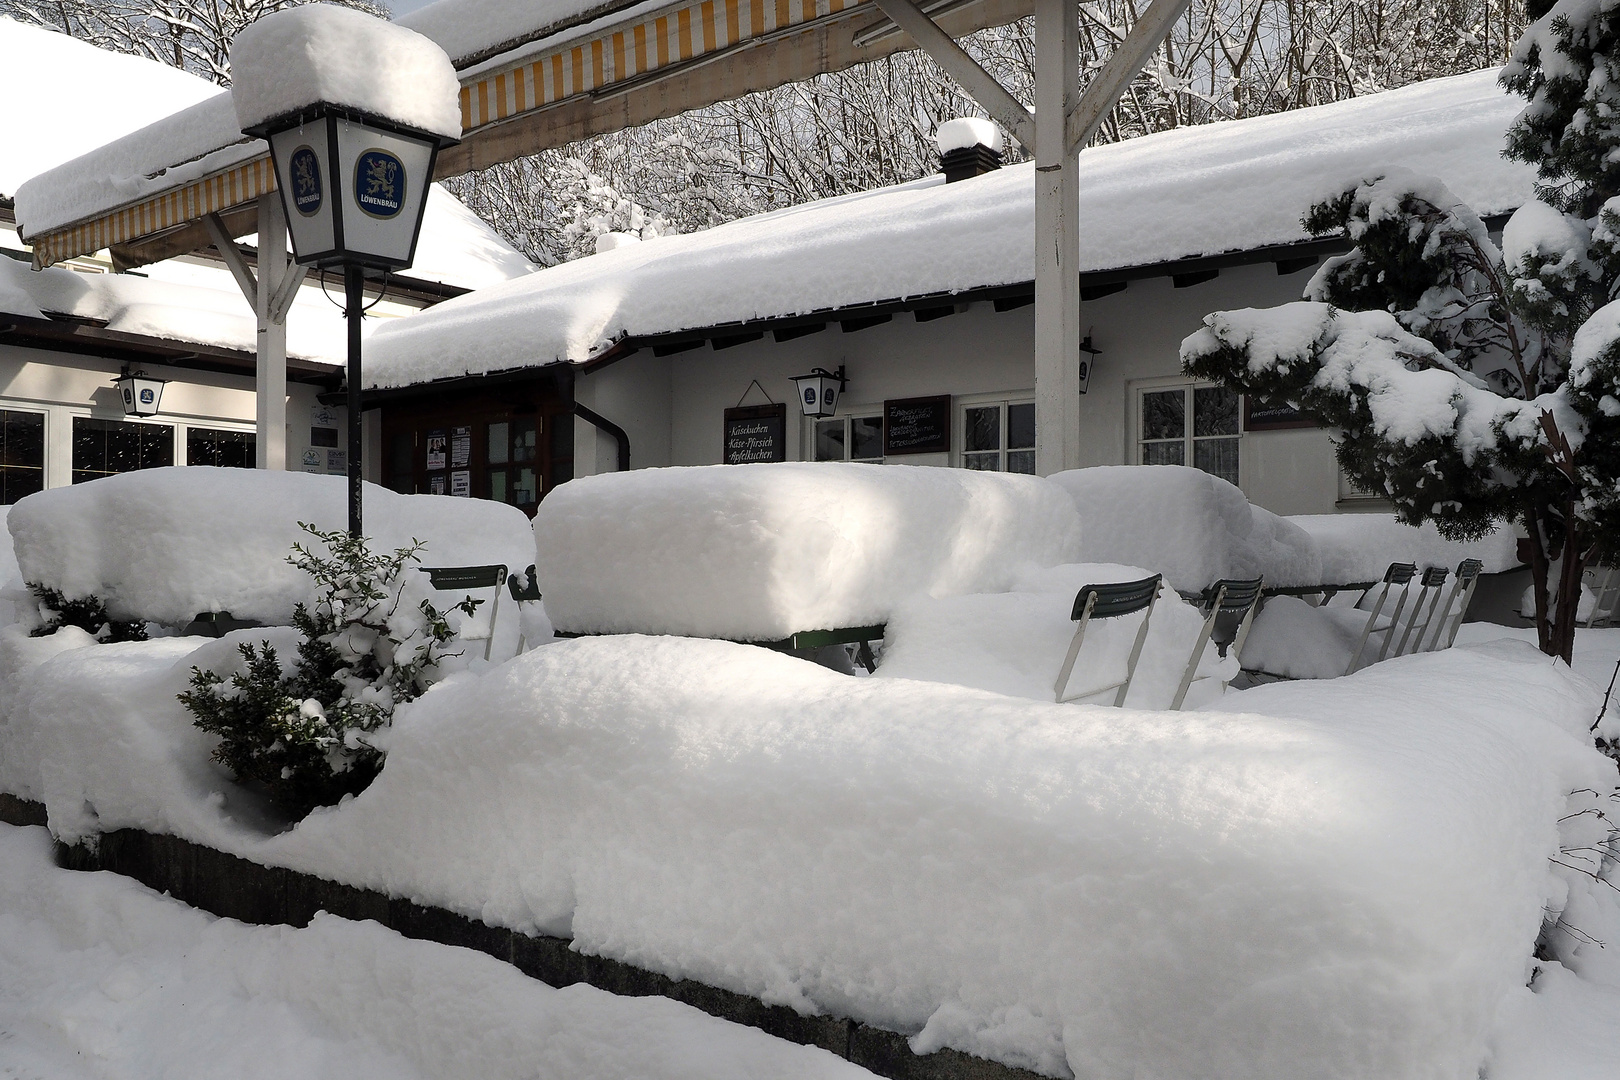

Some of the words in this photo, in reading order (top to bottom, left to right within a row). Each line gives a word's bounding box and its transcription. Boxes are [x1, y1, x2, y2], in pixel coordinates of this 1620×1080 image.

[360, 193, 398, 209] LÖWENBRÄU
[731, 423, 768, 437] Käsekuchen
[729, 436, 773, 450] Käse-Pfirsich
[730, 449, 773, 463] Apfelkuchen
